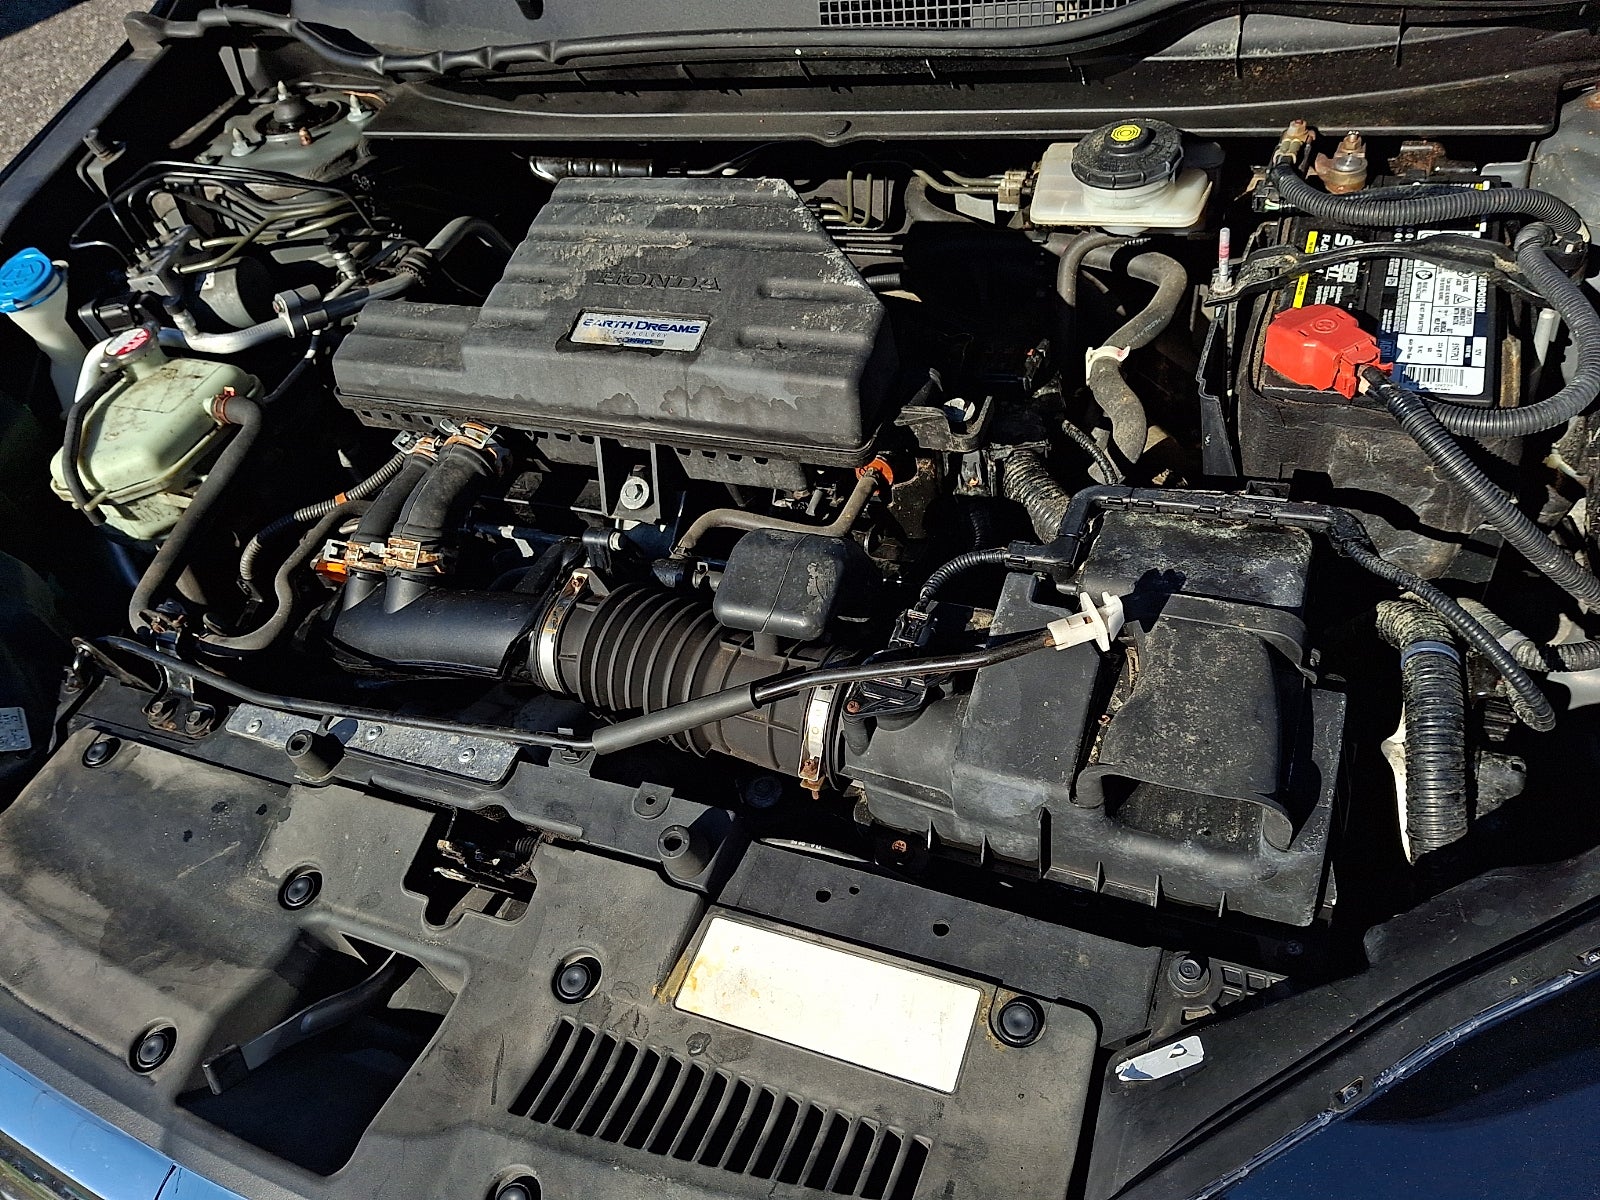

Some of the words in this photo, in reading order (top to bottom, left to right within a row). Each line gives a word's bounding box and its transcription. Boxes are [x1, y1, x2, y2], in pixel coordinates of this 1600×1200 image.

[594, 271, 722, 293] HONDA
[1476, 276, 1488, 312] ER/POISON
[583, 318, 634, 330] EARTH
[635, 320, 701, 334] DREAMS
